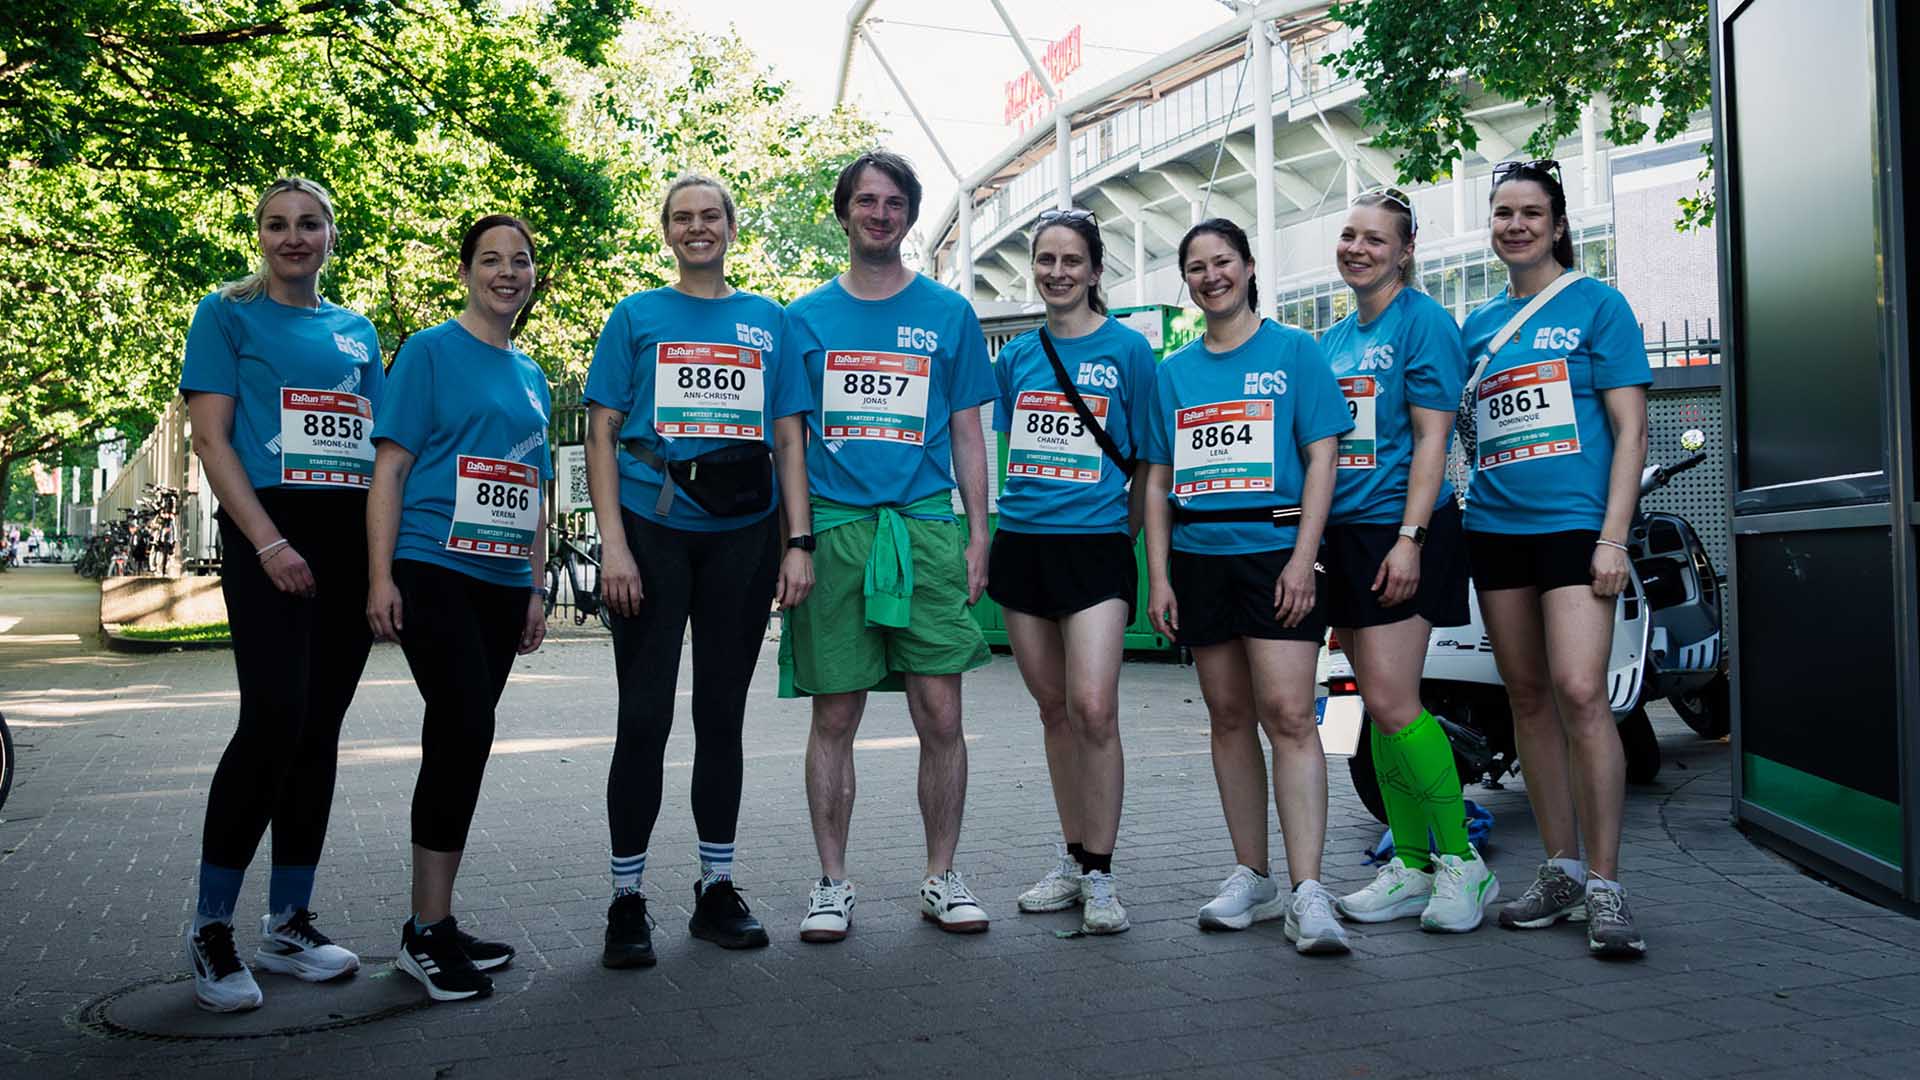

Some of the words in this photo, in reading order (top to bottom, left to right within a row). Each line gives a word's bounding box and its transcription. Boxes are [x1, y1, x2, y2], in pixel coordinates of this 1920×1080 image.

[678, 367, 746, 391] 8860
[844, 374, 910, 397] 8857
[683, 392, 741, 401] ANN-CHRISTIN
[863, 397, 888, 406] JONAS
[1489, 387, 1550, 421] 8861
[304, 414, 363, 440] 8858
[1027, 413, 1085, 437] 8863
[1498, 413, 1541, 428] DOMINIQUE
[1037, 436, 1069, 446] CHANTAL
[1192, 424, 1253, 450] 8864
[1210, 448, 1229, 457] LENA
[477, 483, 529, 511] 8866
[491, 509, 516, 519] VERENA
